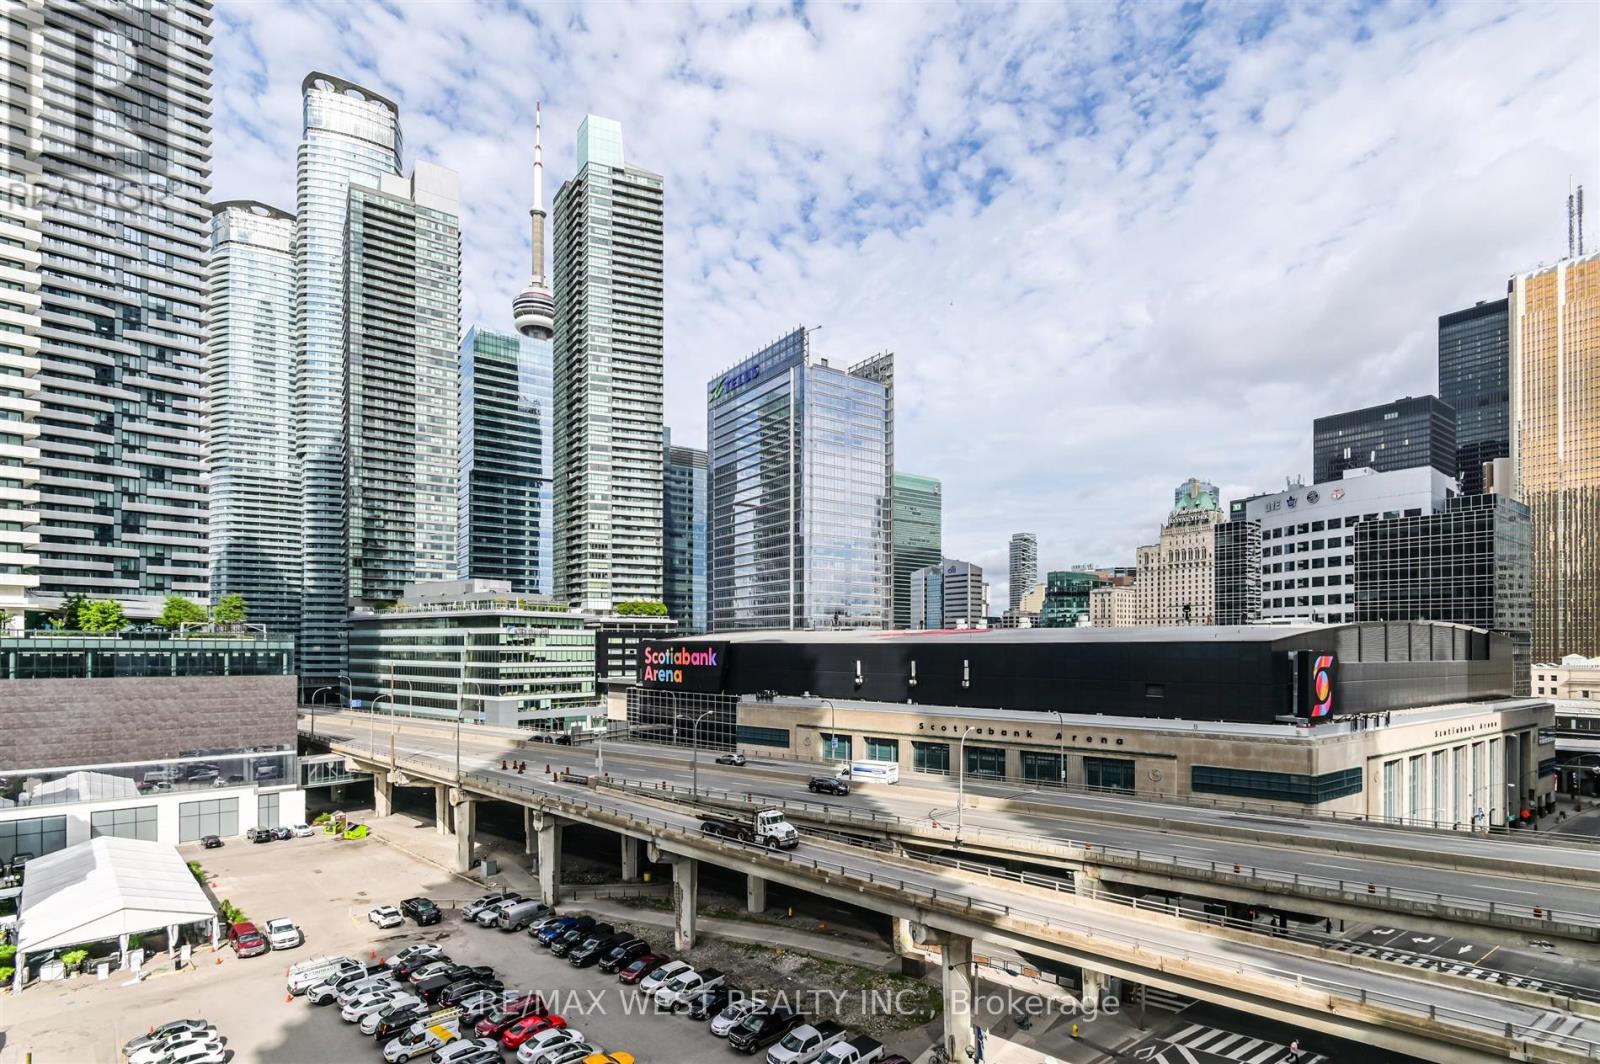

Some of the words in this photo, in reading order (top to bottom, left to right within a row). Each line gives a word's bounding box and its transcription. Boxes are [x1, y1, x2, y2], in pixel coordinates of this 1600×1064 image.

[644, 646, 717, 666] Scotiabank
[644, 665, 683, 683] Arena
[918, 722, 1033, 739] Scotiabank
[1055, 732, 1124, 745] Arena
[1434, 724, 1475, 737] Scotiabank
